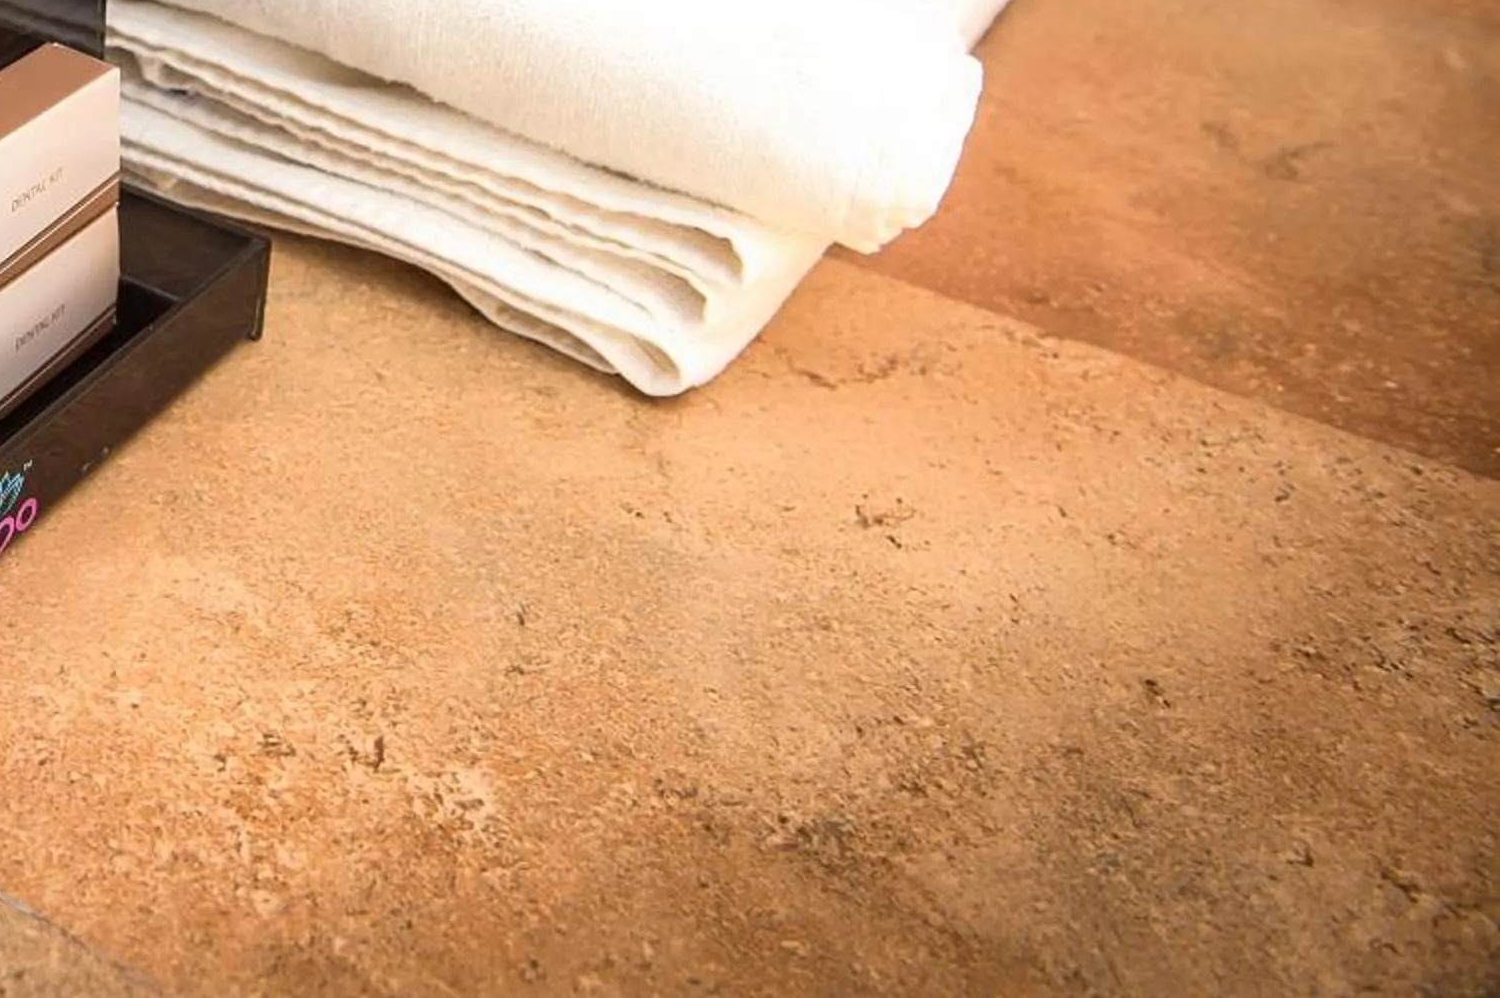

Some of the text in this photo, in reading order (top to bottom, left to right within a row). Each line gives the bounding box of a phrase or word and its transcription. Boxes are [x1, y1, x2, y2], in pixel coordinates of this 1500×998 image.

[11, 165, 64, 214] DENTAL KIT
[14, 303, 67, 352] DENTAL KIT
